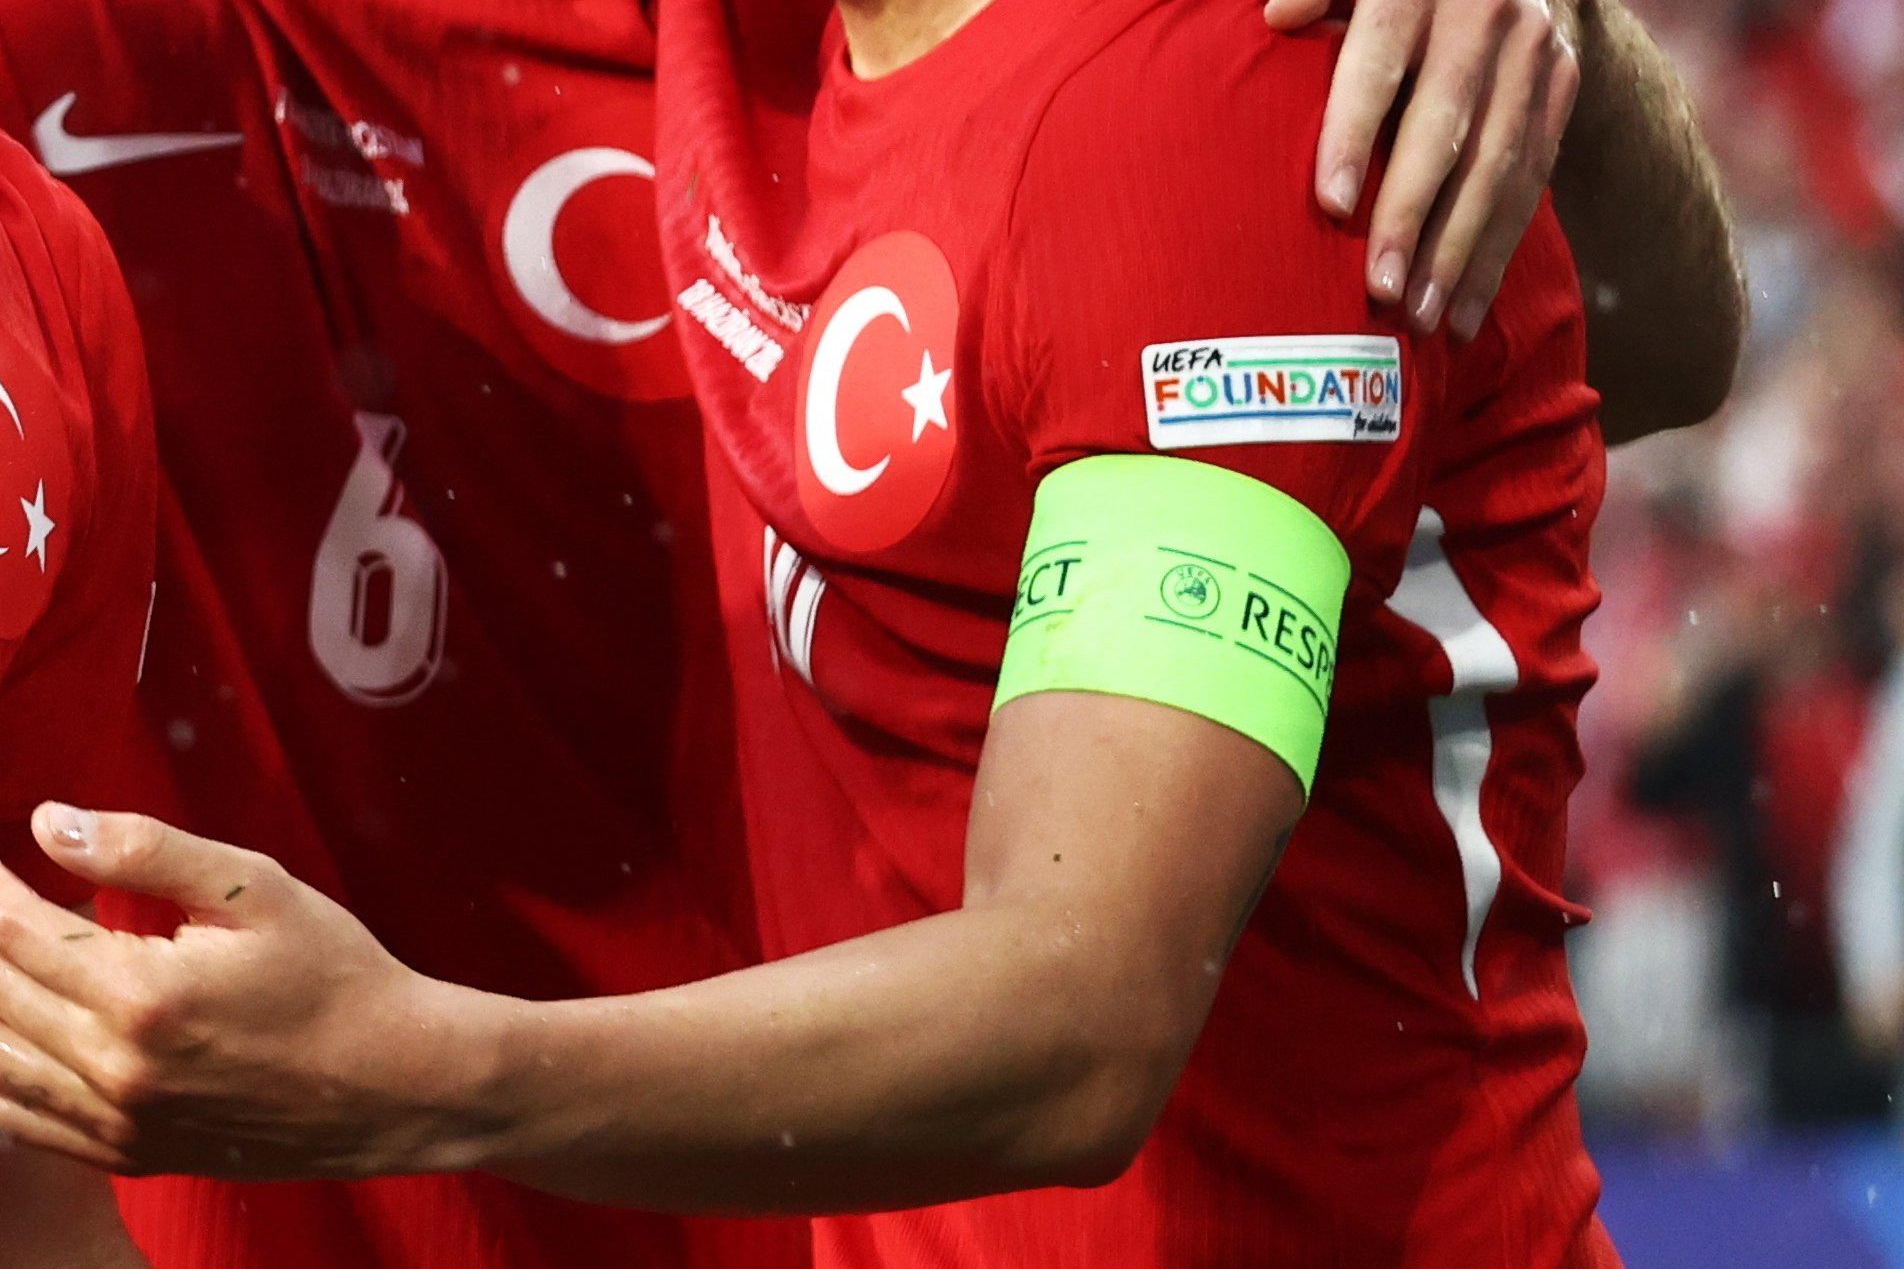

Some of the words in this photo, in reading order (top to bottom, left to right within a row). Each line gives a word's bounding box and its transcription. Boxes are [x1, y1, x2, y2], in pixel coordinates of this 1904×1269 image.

[1152, 347, 1223, 373] UEFA
[1154, 369, 1398, 411] FOUNDATION
[307, 409, 448, 708] 6
